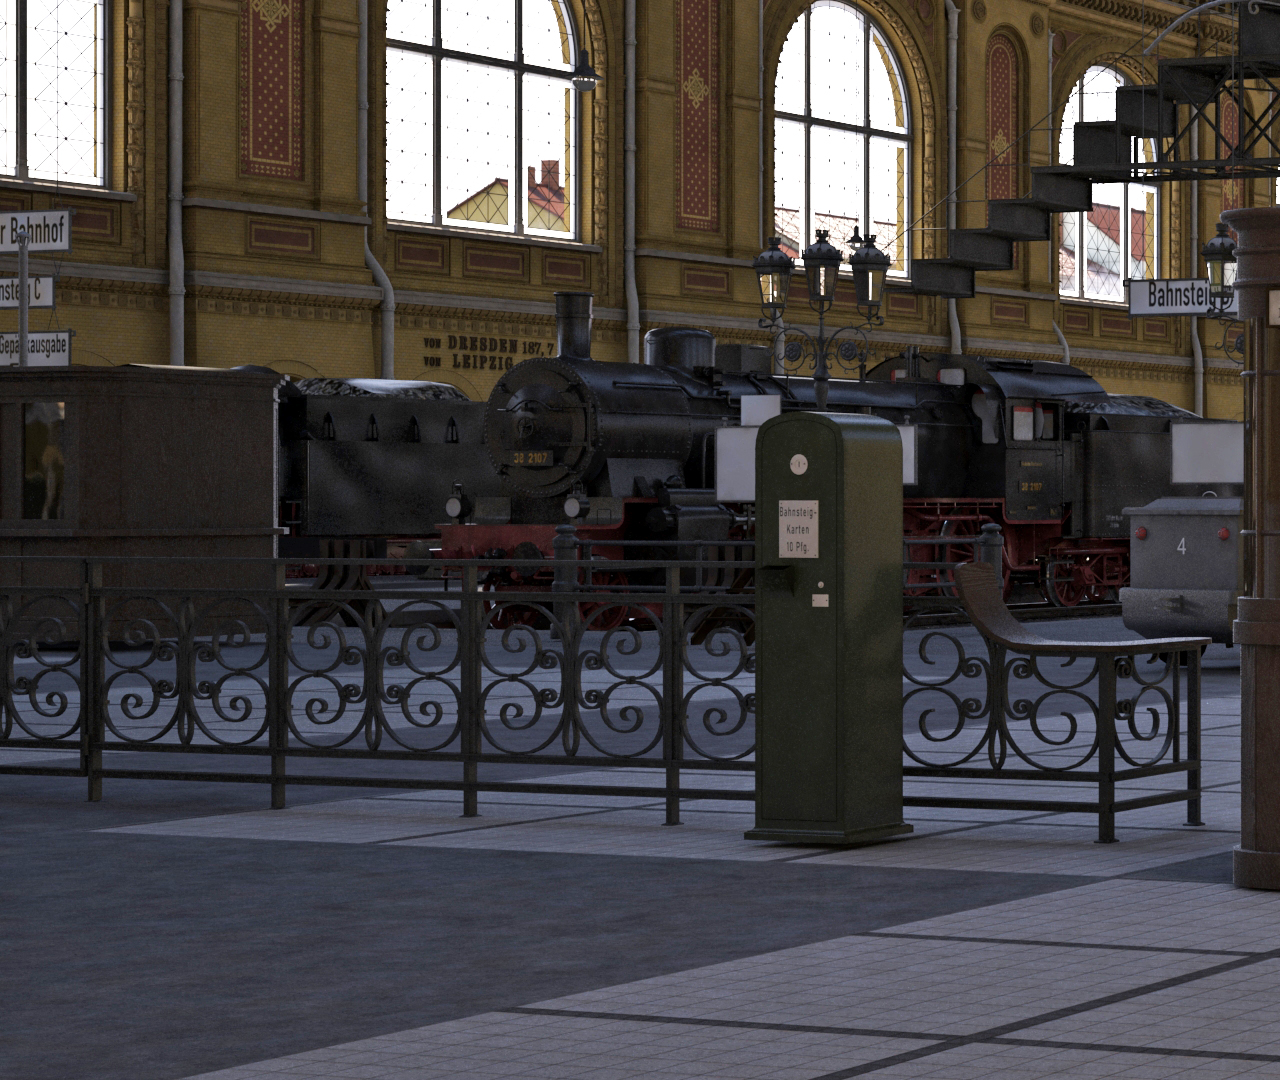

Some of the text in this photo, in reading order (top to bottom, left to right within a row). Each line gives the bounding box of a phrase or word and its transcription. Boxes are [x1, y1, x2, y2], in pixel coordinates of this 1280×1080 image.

[34, 277, 41, 300] C
[424, 338, 441, 348] VON
[448, 335, 518, 353] DRESDEN
[424, 354, 514, 371] VON LEIPZIG
[528, 453, 548, 464] 2107
[780, 507, 817, 519] Bahnsteig-
[787, 524, 810, 534] Karten
[786, 541, 810, 555] 10 Pfg.
[1176, 537, 1187, 555] 4
